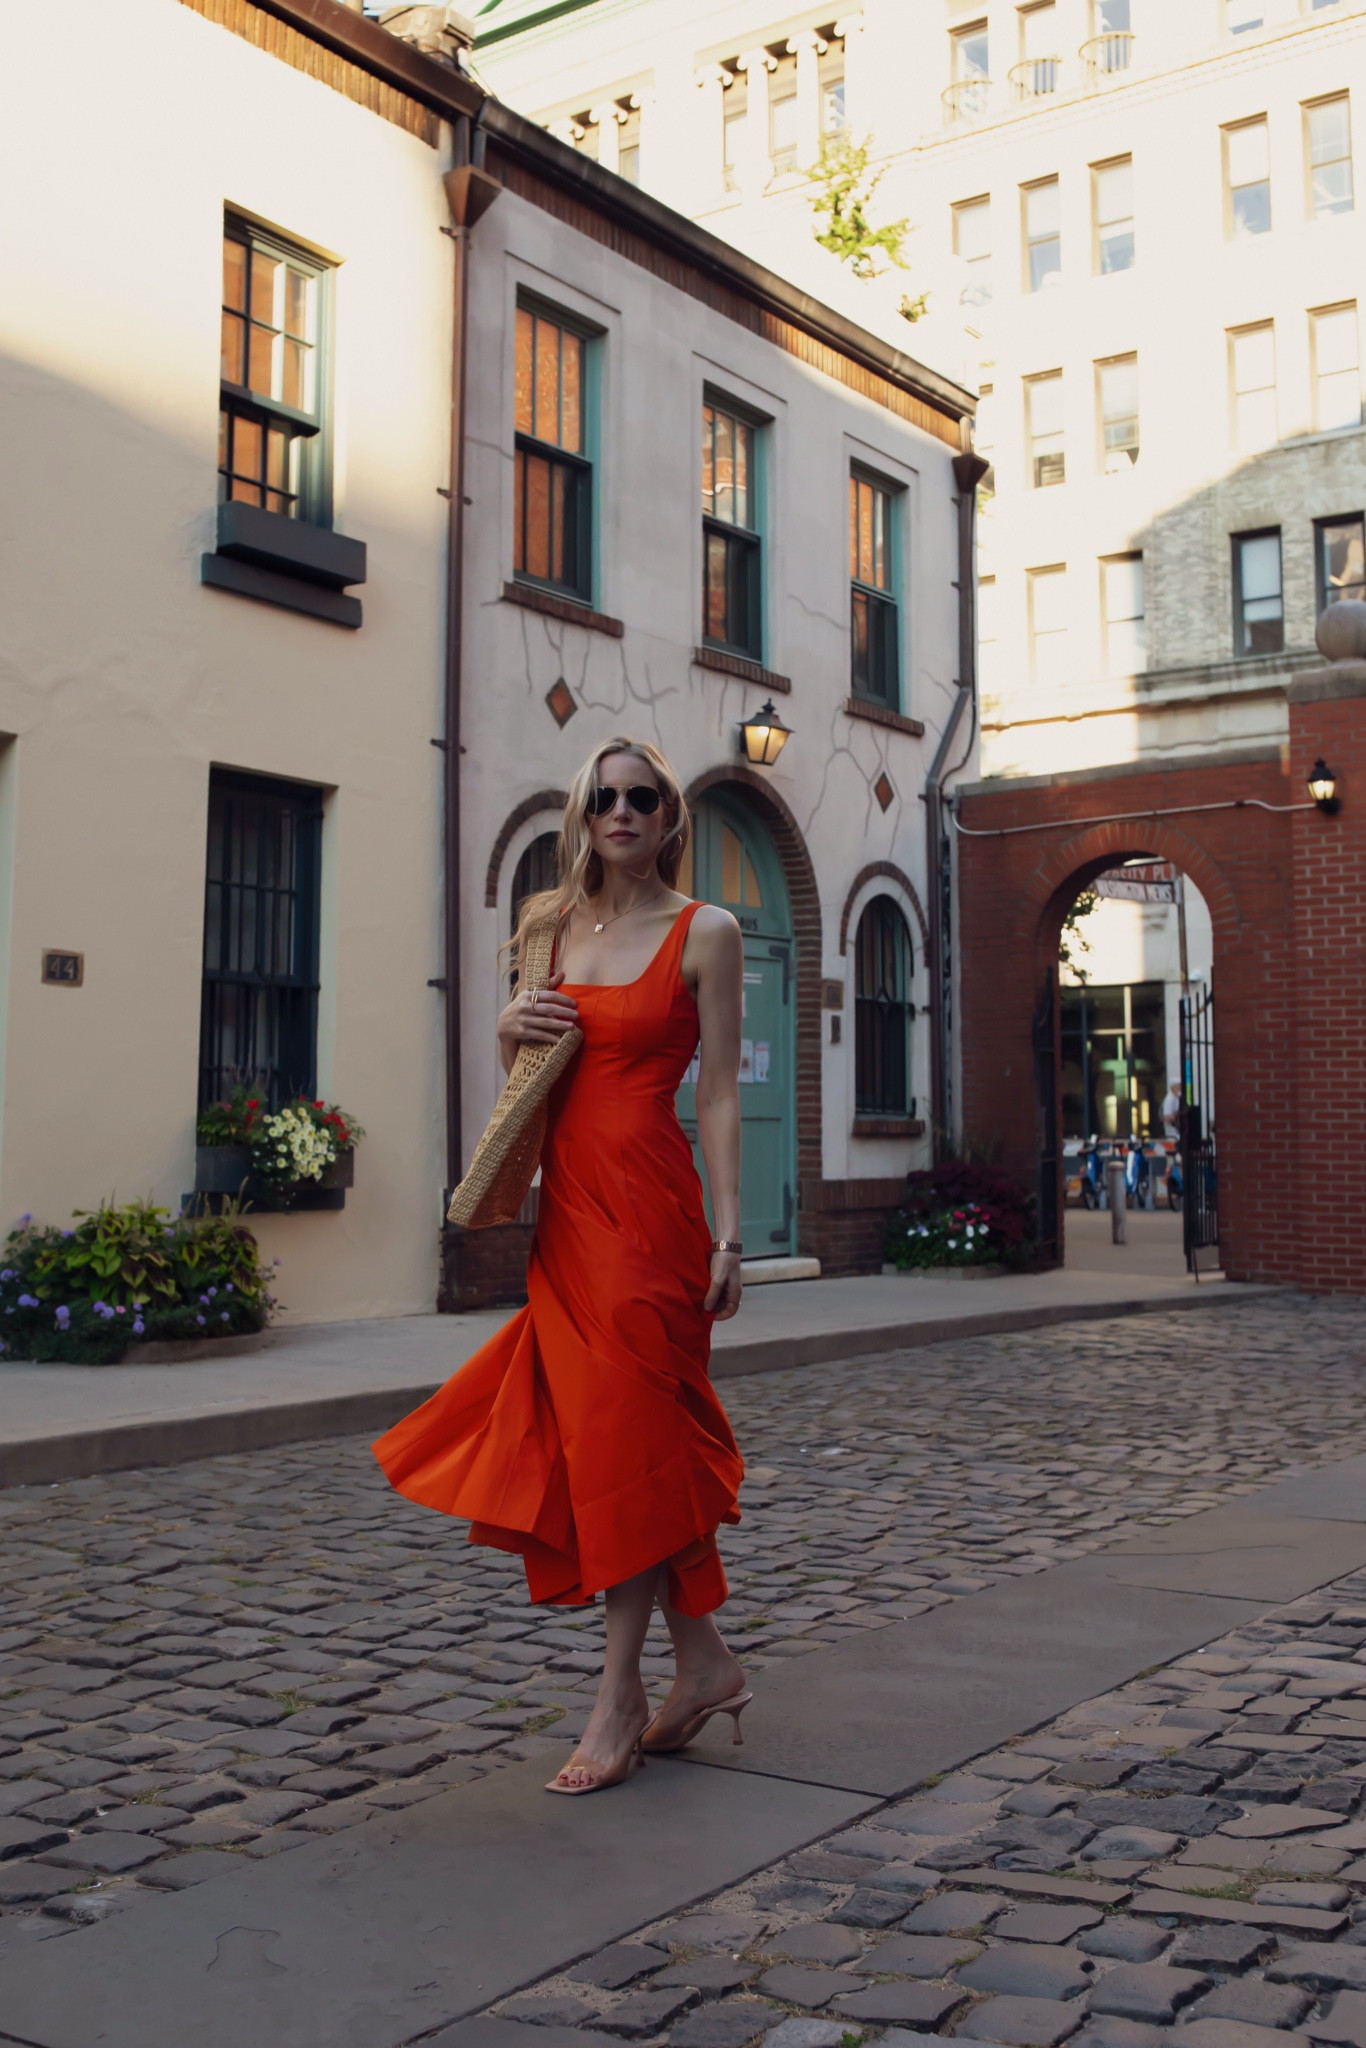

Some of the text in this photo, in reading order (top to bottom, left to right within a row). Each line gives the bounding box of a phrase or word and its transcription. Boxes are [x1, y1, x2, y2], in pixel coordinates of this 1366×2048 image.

[1100, 867, 1146, 881] ERSITY
[1147, 884, 1173, 903] MEWS
[738, 917, 758, 931] AUS
[49, 957, 74, 979] 44
